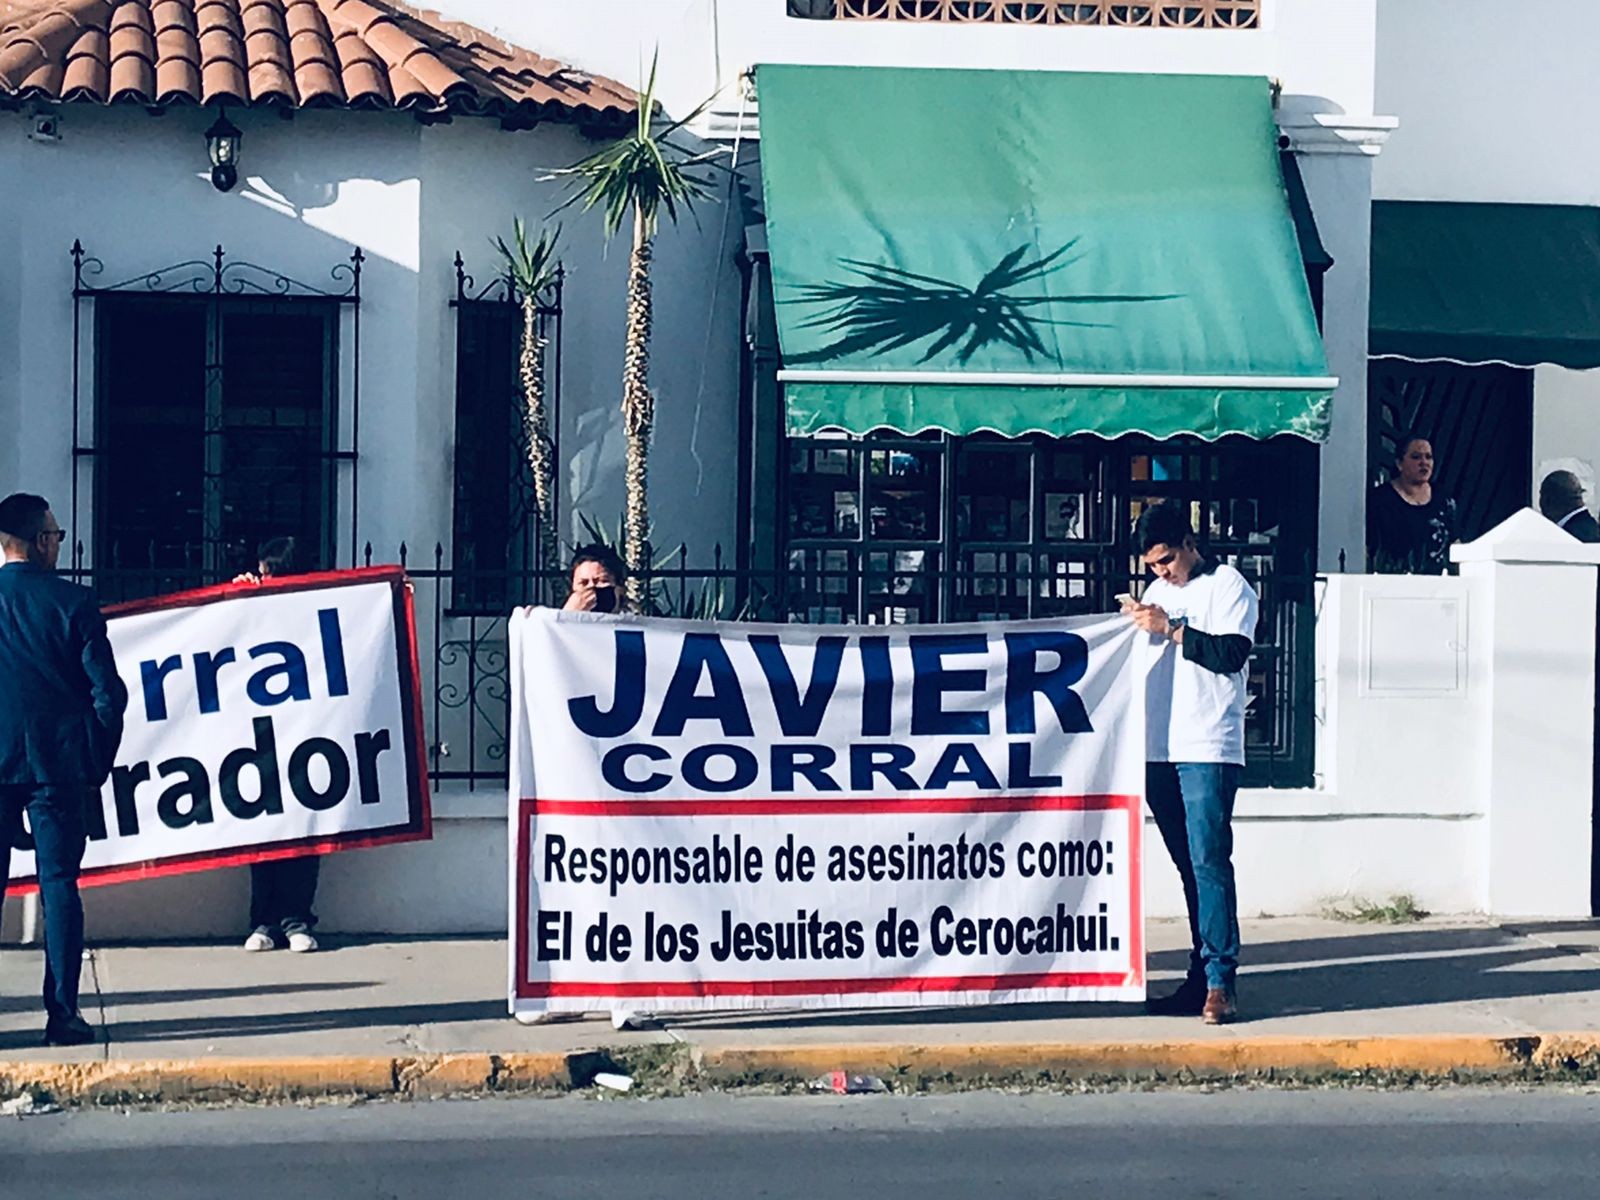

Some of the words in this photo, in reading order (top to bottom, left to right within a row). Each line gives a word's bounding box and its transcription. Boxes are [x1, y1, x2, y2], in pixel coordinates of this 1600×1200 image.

[140, 608, 350, 722] rral
[568, 629, 1094, 738] JAVIER
[10, 716, 391, 851] rador
[602, 742, 1062, 793] CORRAL
[544, 834, 763, 896] Responsable
[776, 834, 815, 882] de
[828, 832, 1005, 881] asesinatos
[1017, 840, 1113, 878] como:
[537, 910, 572, 962] El
[586, 911, 631, 962] de
[645, 911, 699, 962] los
[711, 910, 864, 962] Jesuitas
[876, 907, 919, 957] de
[930, 902, 1119, 957] Cerocahui.
